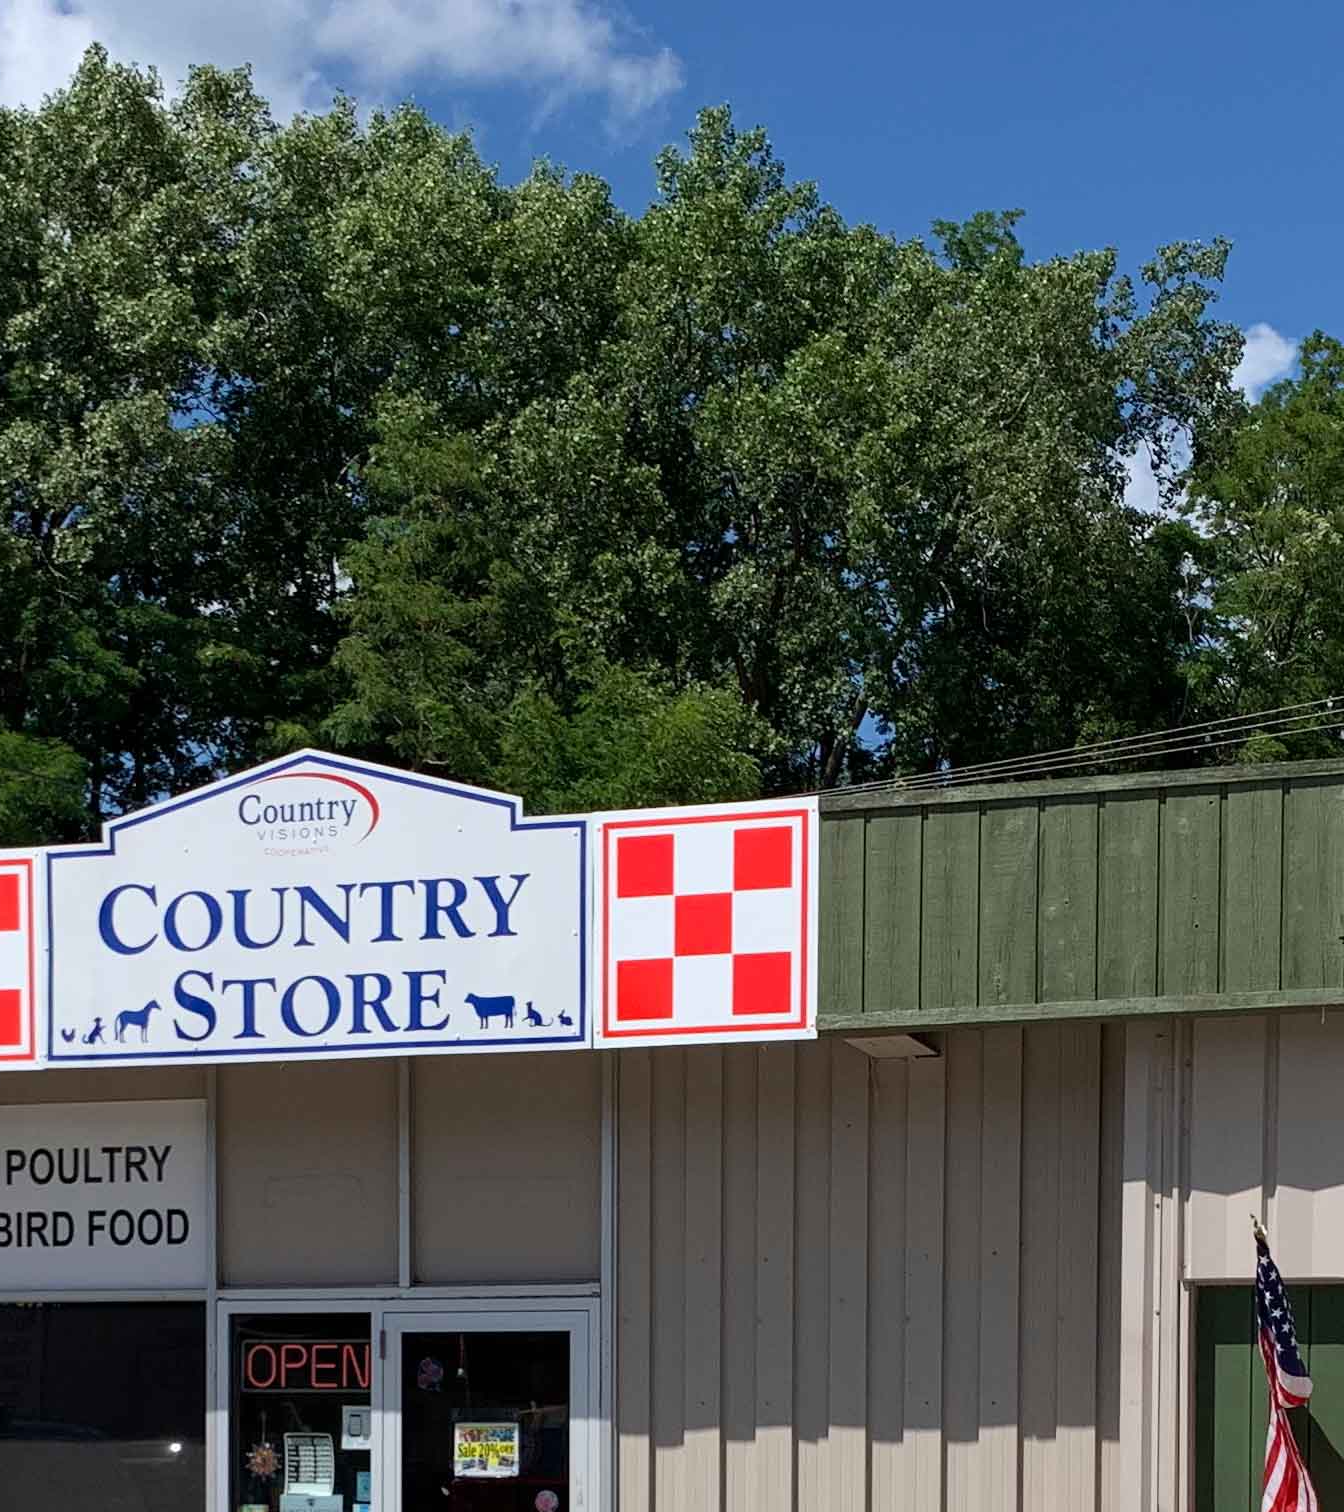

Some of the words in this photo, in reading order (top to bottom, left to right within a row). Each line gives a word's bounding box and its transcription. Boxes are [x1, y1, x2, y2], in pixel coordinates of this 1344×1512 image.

[238, 794, 358, 826] Country
[256, 826, 338, 841] VISIONS
[98, 873, 530, 955] COUNTRY
[173, 969, 450, 1042] STORE
[5, 1145, 172, 1185] POULTRY
[87, 1209, 190, 1246] FOOD
[247, 1343, 370, 1388] OPEN
